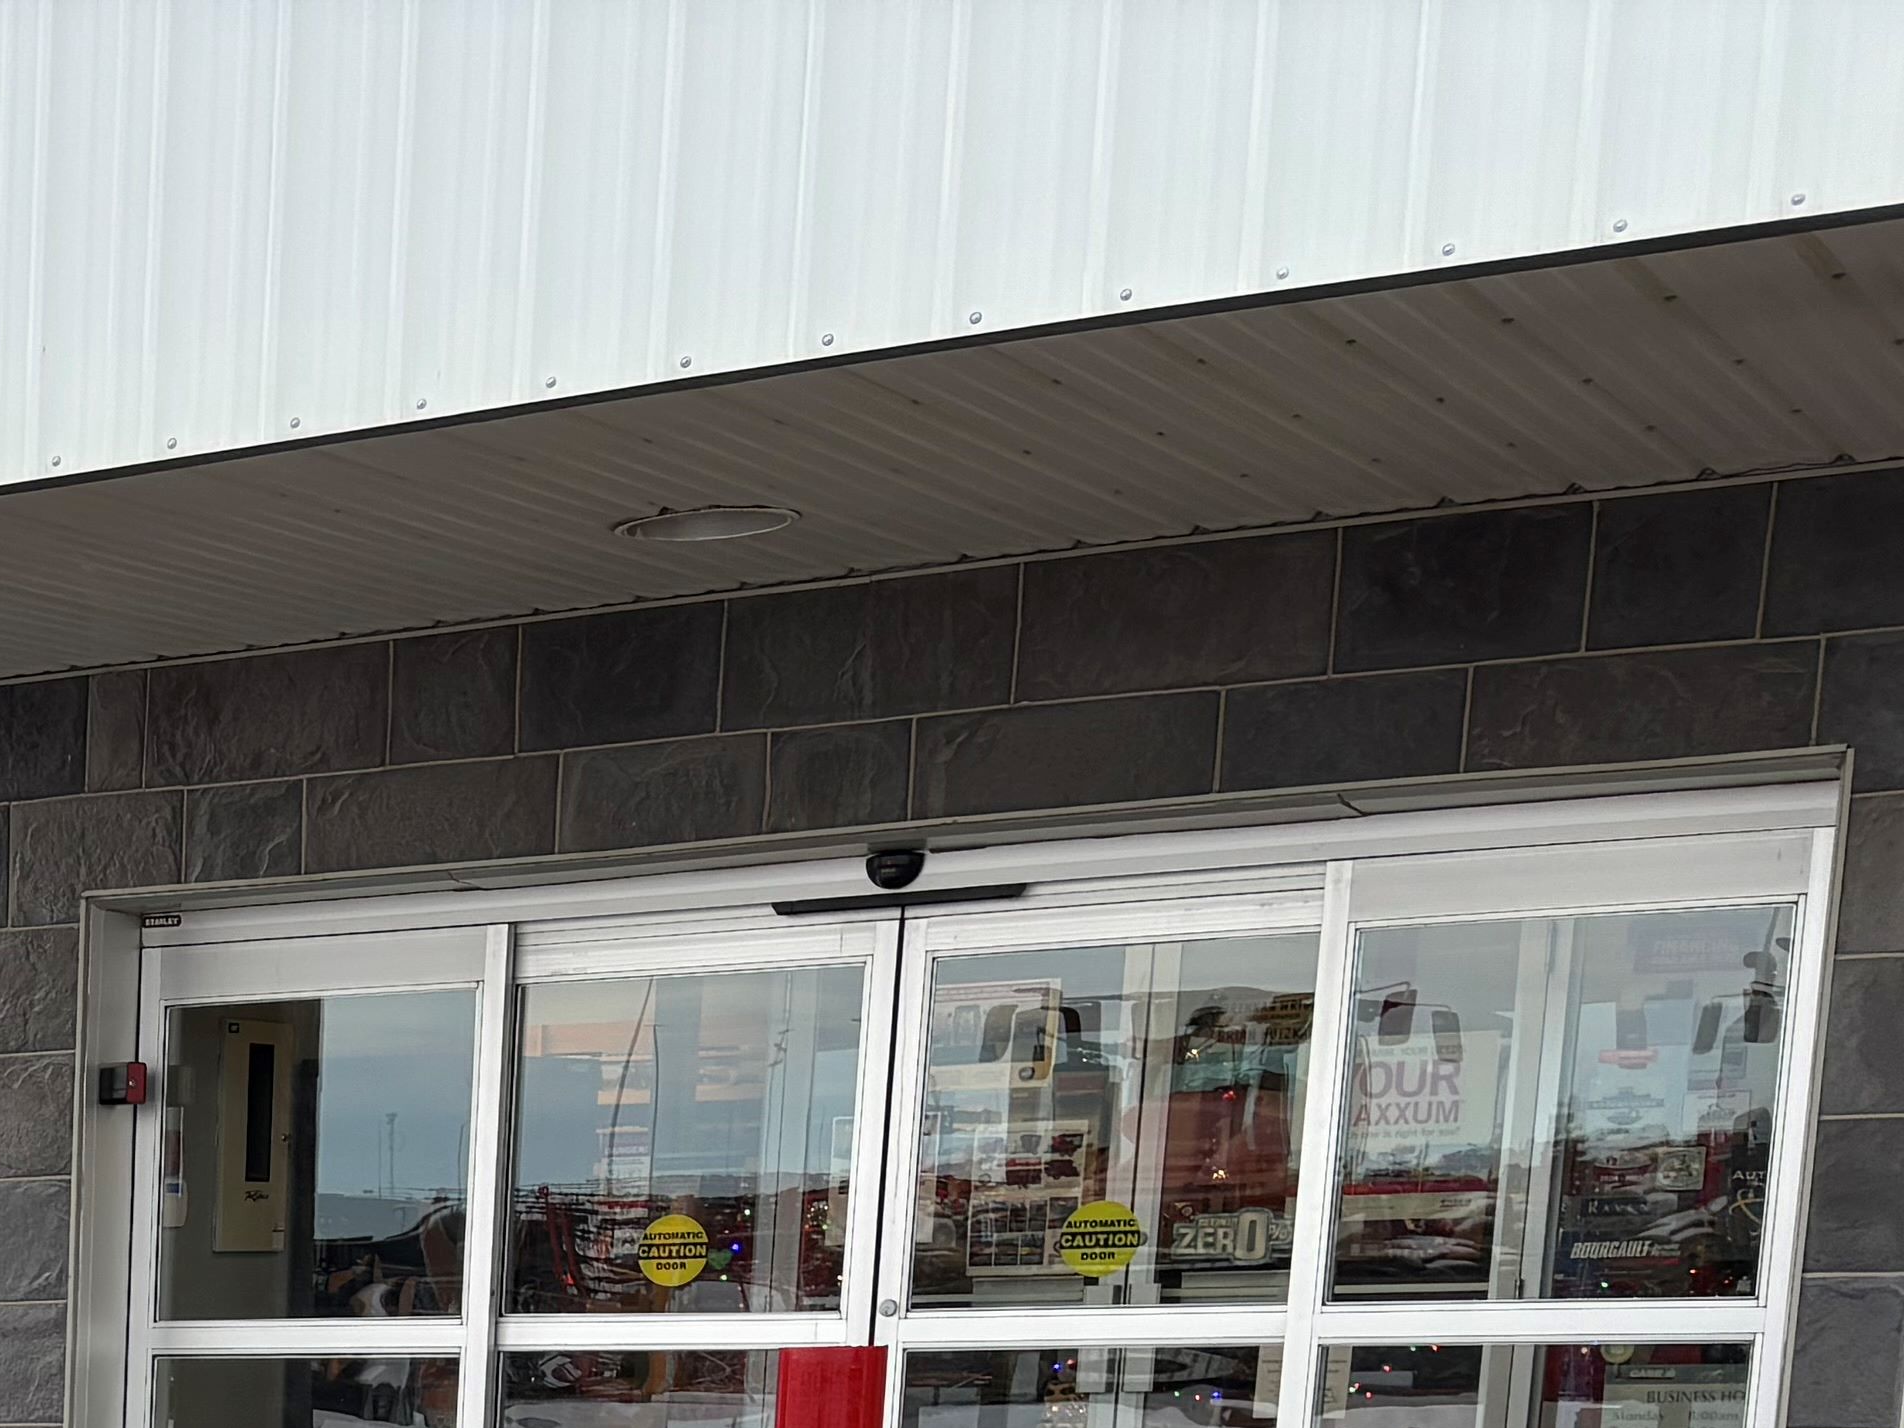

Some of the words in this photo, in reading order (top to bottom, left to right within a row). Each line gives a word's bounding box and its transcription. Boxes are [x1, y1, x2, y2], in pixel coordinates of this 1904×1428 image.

[1065, 1219, 1136, 1229] AUTOMATIC
[642, 1231, 704, 1240] AUTOMATIC
[1060, 1232, 1139, 1247] CAUTION
[639, 1244, 707, 1257] CAUTION
[1080, 1251, 1115, 1260] DOOR
[656, 1261, 687, 1270] DOOR
[1647, 1390, 1717, 1403] BUSINESS
